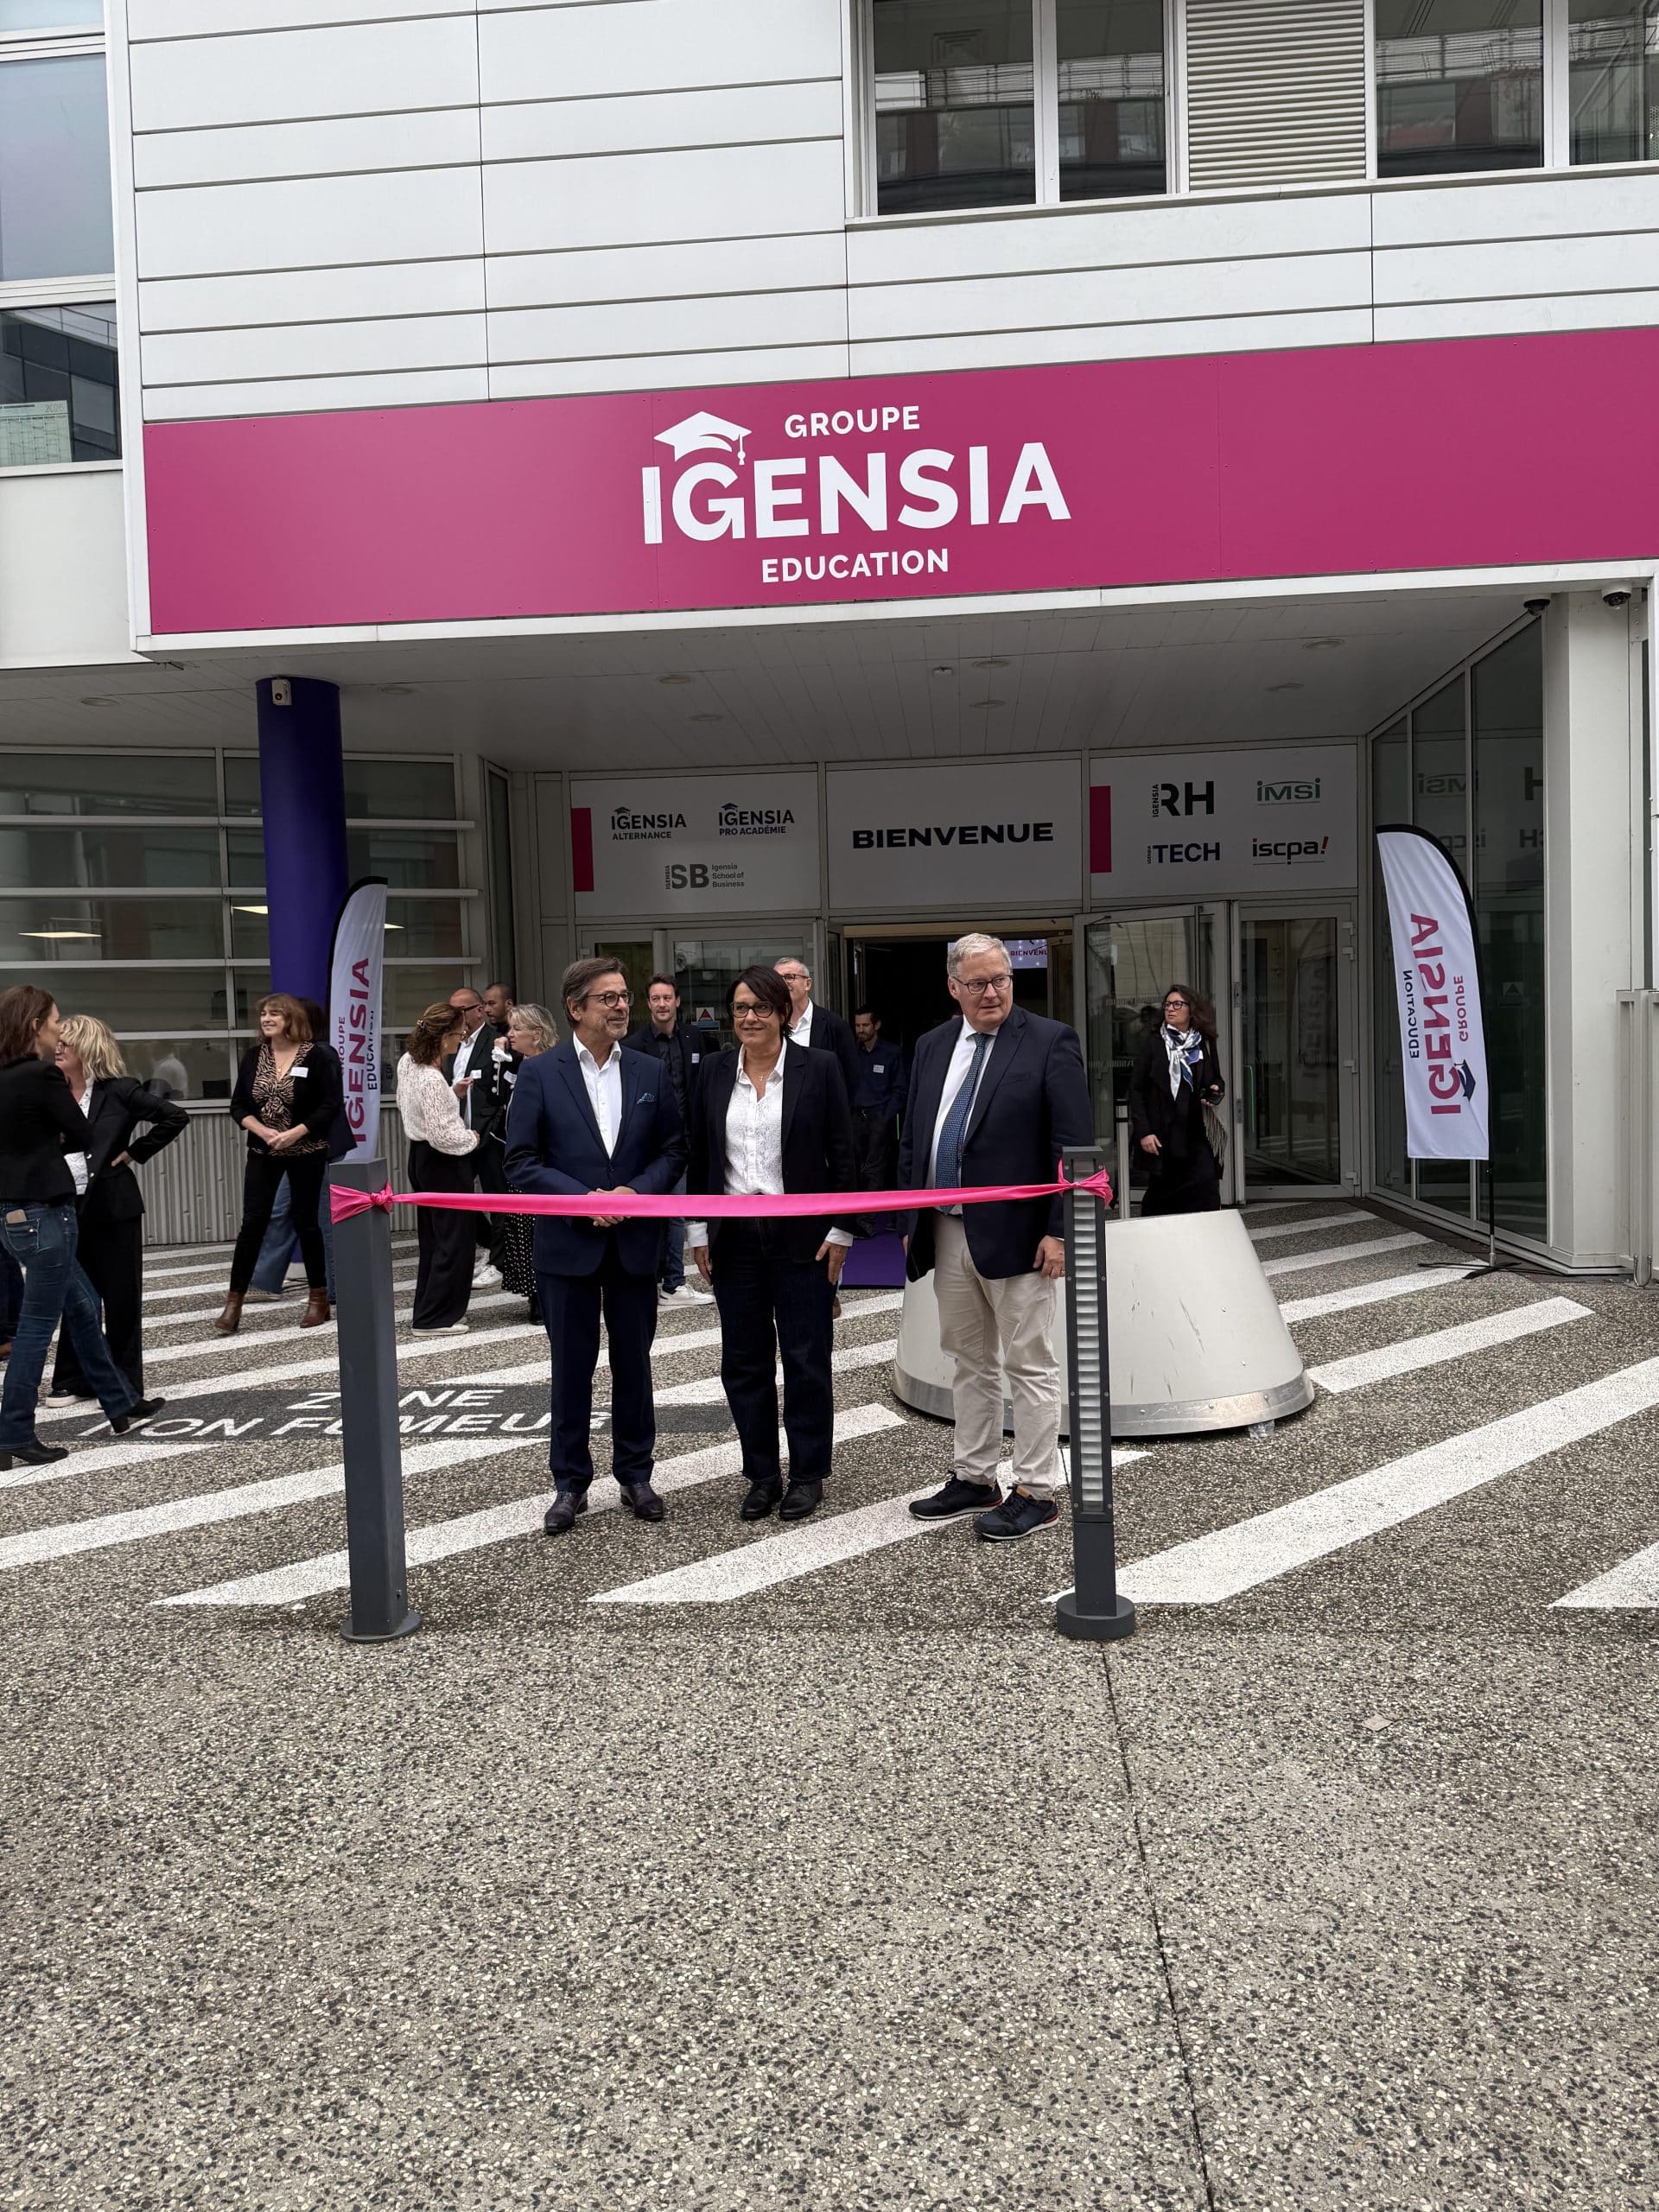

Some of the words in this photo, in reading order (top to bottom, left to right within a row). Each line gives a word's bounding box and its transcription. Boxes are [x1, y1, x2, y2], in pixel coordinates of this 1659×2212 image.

[784, 405, 920, 438] GROUPE
[641, 442, 1071, 544] IGENSIA
[761, 548, 949, 583] EDUCATION
[1160, 780, 1215, 817] RH
[611, 813, 687, 830] IGENSIA
[718, 809, 795, 826] IGENSIA
[612, 830, 672, 841] ALTERNANCE
[719, 827, 738, 836] PRO
[740, 824, 786, 836] ACADÉMIE
[852, 822, 1053, 849] BIENVENUE
[1153, 842, 1220, 863] TECH
[671, 863, 709, 889] SB
[711, 863, 738, 872] Igensia
[712, 880, 745, 888] Business
[346, 957, 370, 1142] IGENSIA
[366, 1010, 378, 1090] EDUCA
[286, 1389, 505, 1410] ZNE
